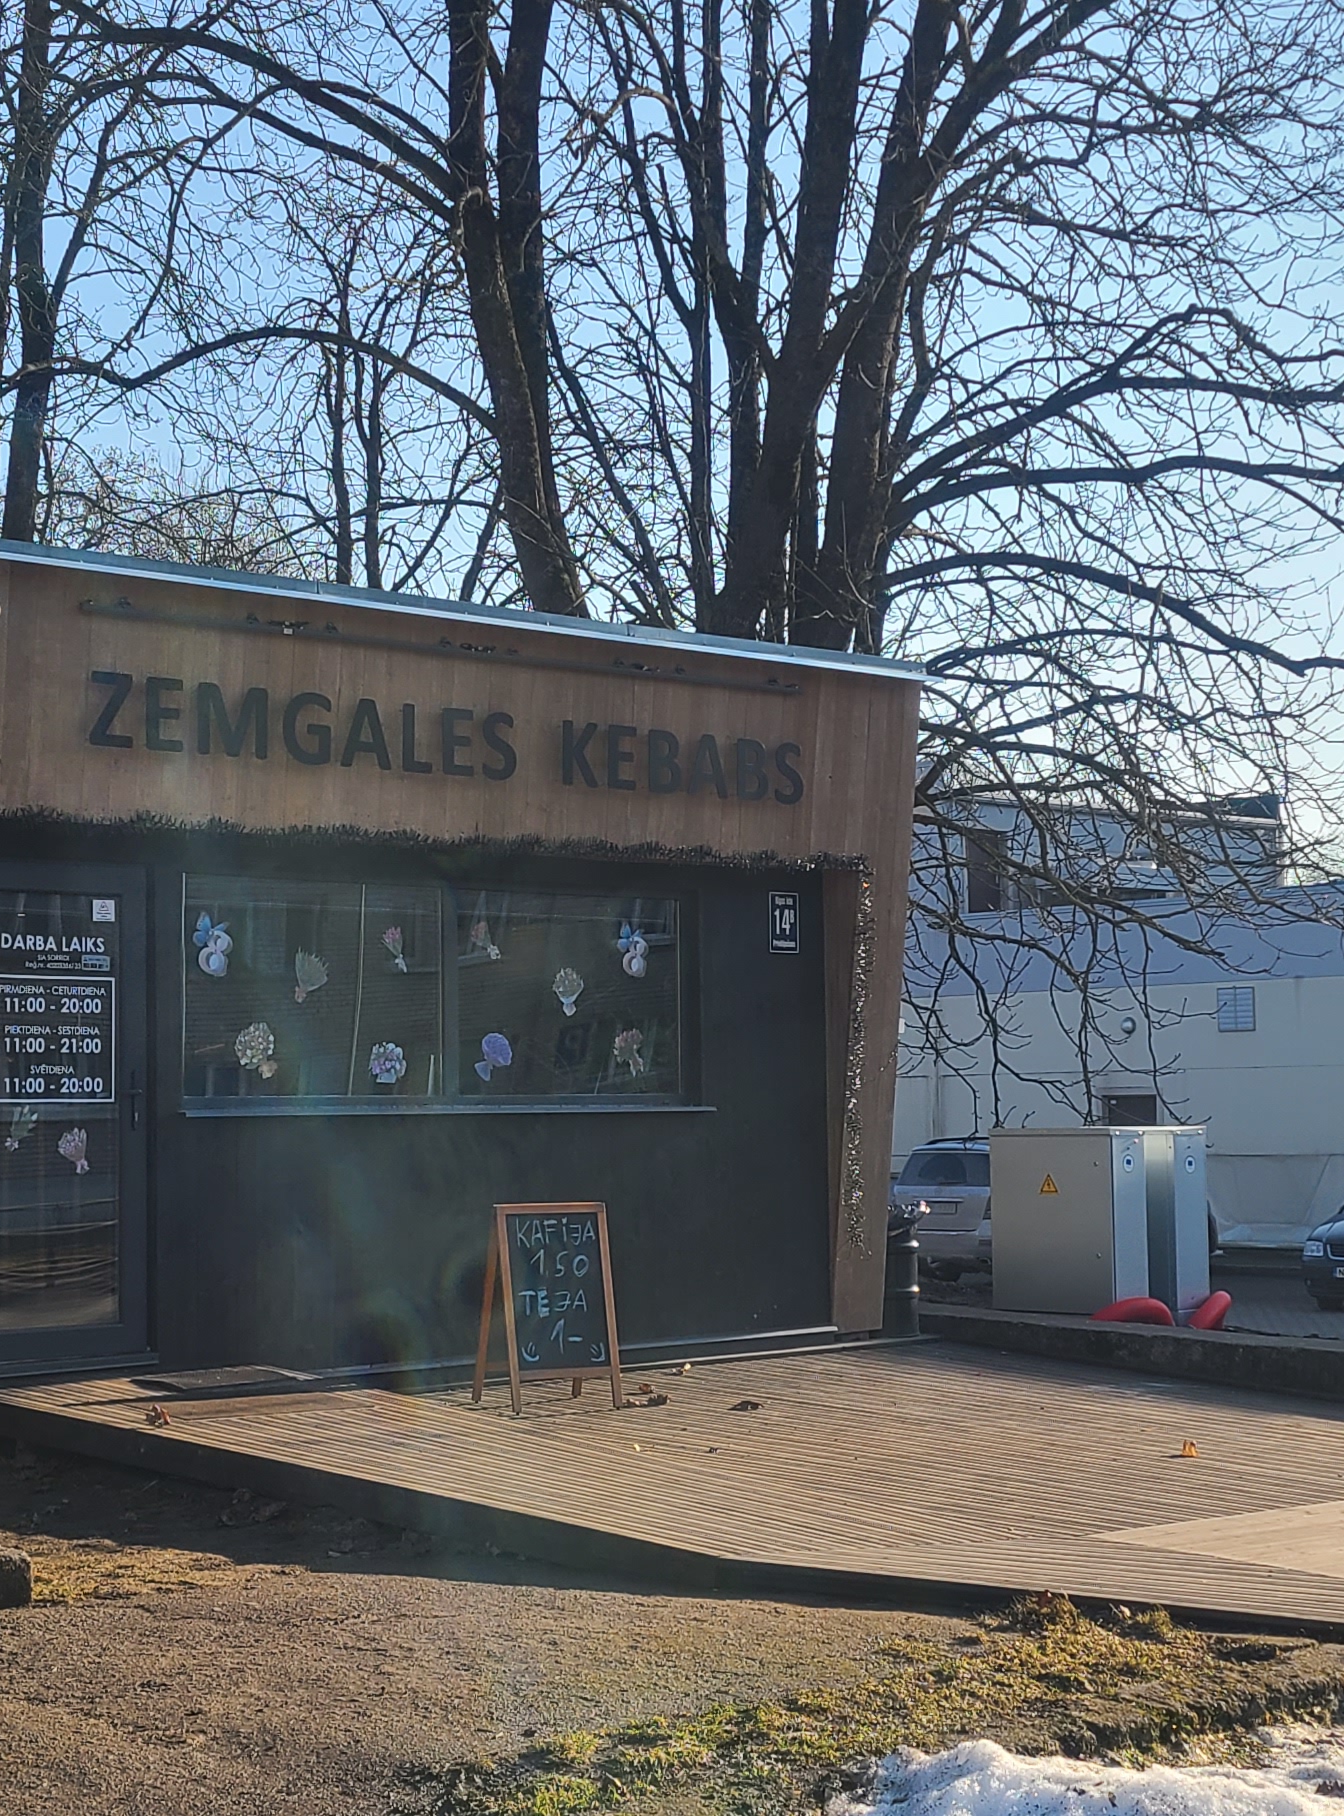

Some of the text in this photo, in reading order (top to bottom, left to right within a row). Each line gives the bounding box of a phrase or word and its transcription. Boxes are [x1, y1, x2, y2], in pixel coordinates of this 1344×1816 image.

[89, 671, 804, 804] ZEMGALES KEBABS
[1, 933, 105, 952] DARBA LAIKS
[0, 985, 45, 994] PIRMDIENA
[52, 986, 106, 996] CETURTDIENA
[4, 998, 45, 1012] 11:00
[61, 998, 101, 1014] 20:00
[4, 1026, 51, 1035] PIEKTDIENA
[58, 1026, 100, 1035] SESTDIENA
[4, 1038, 45, 1053] 11:00
[60, 1038, 101, 1053] 21:00
[30, 1064, 74, 1074] SVĒTDIENA
[4, 1078, 45, 1093] 11:00
[60, 1077, 103, 1093] 20:00
